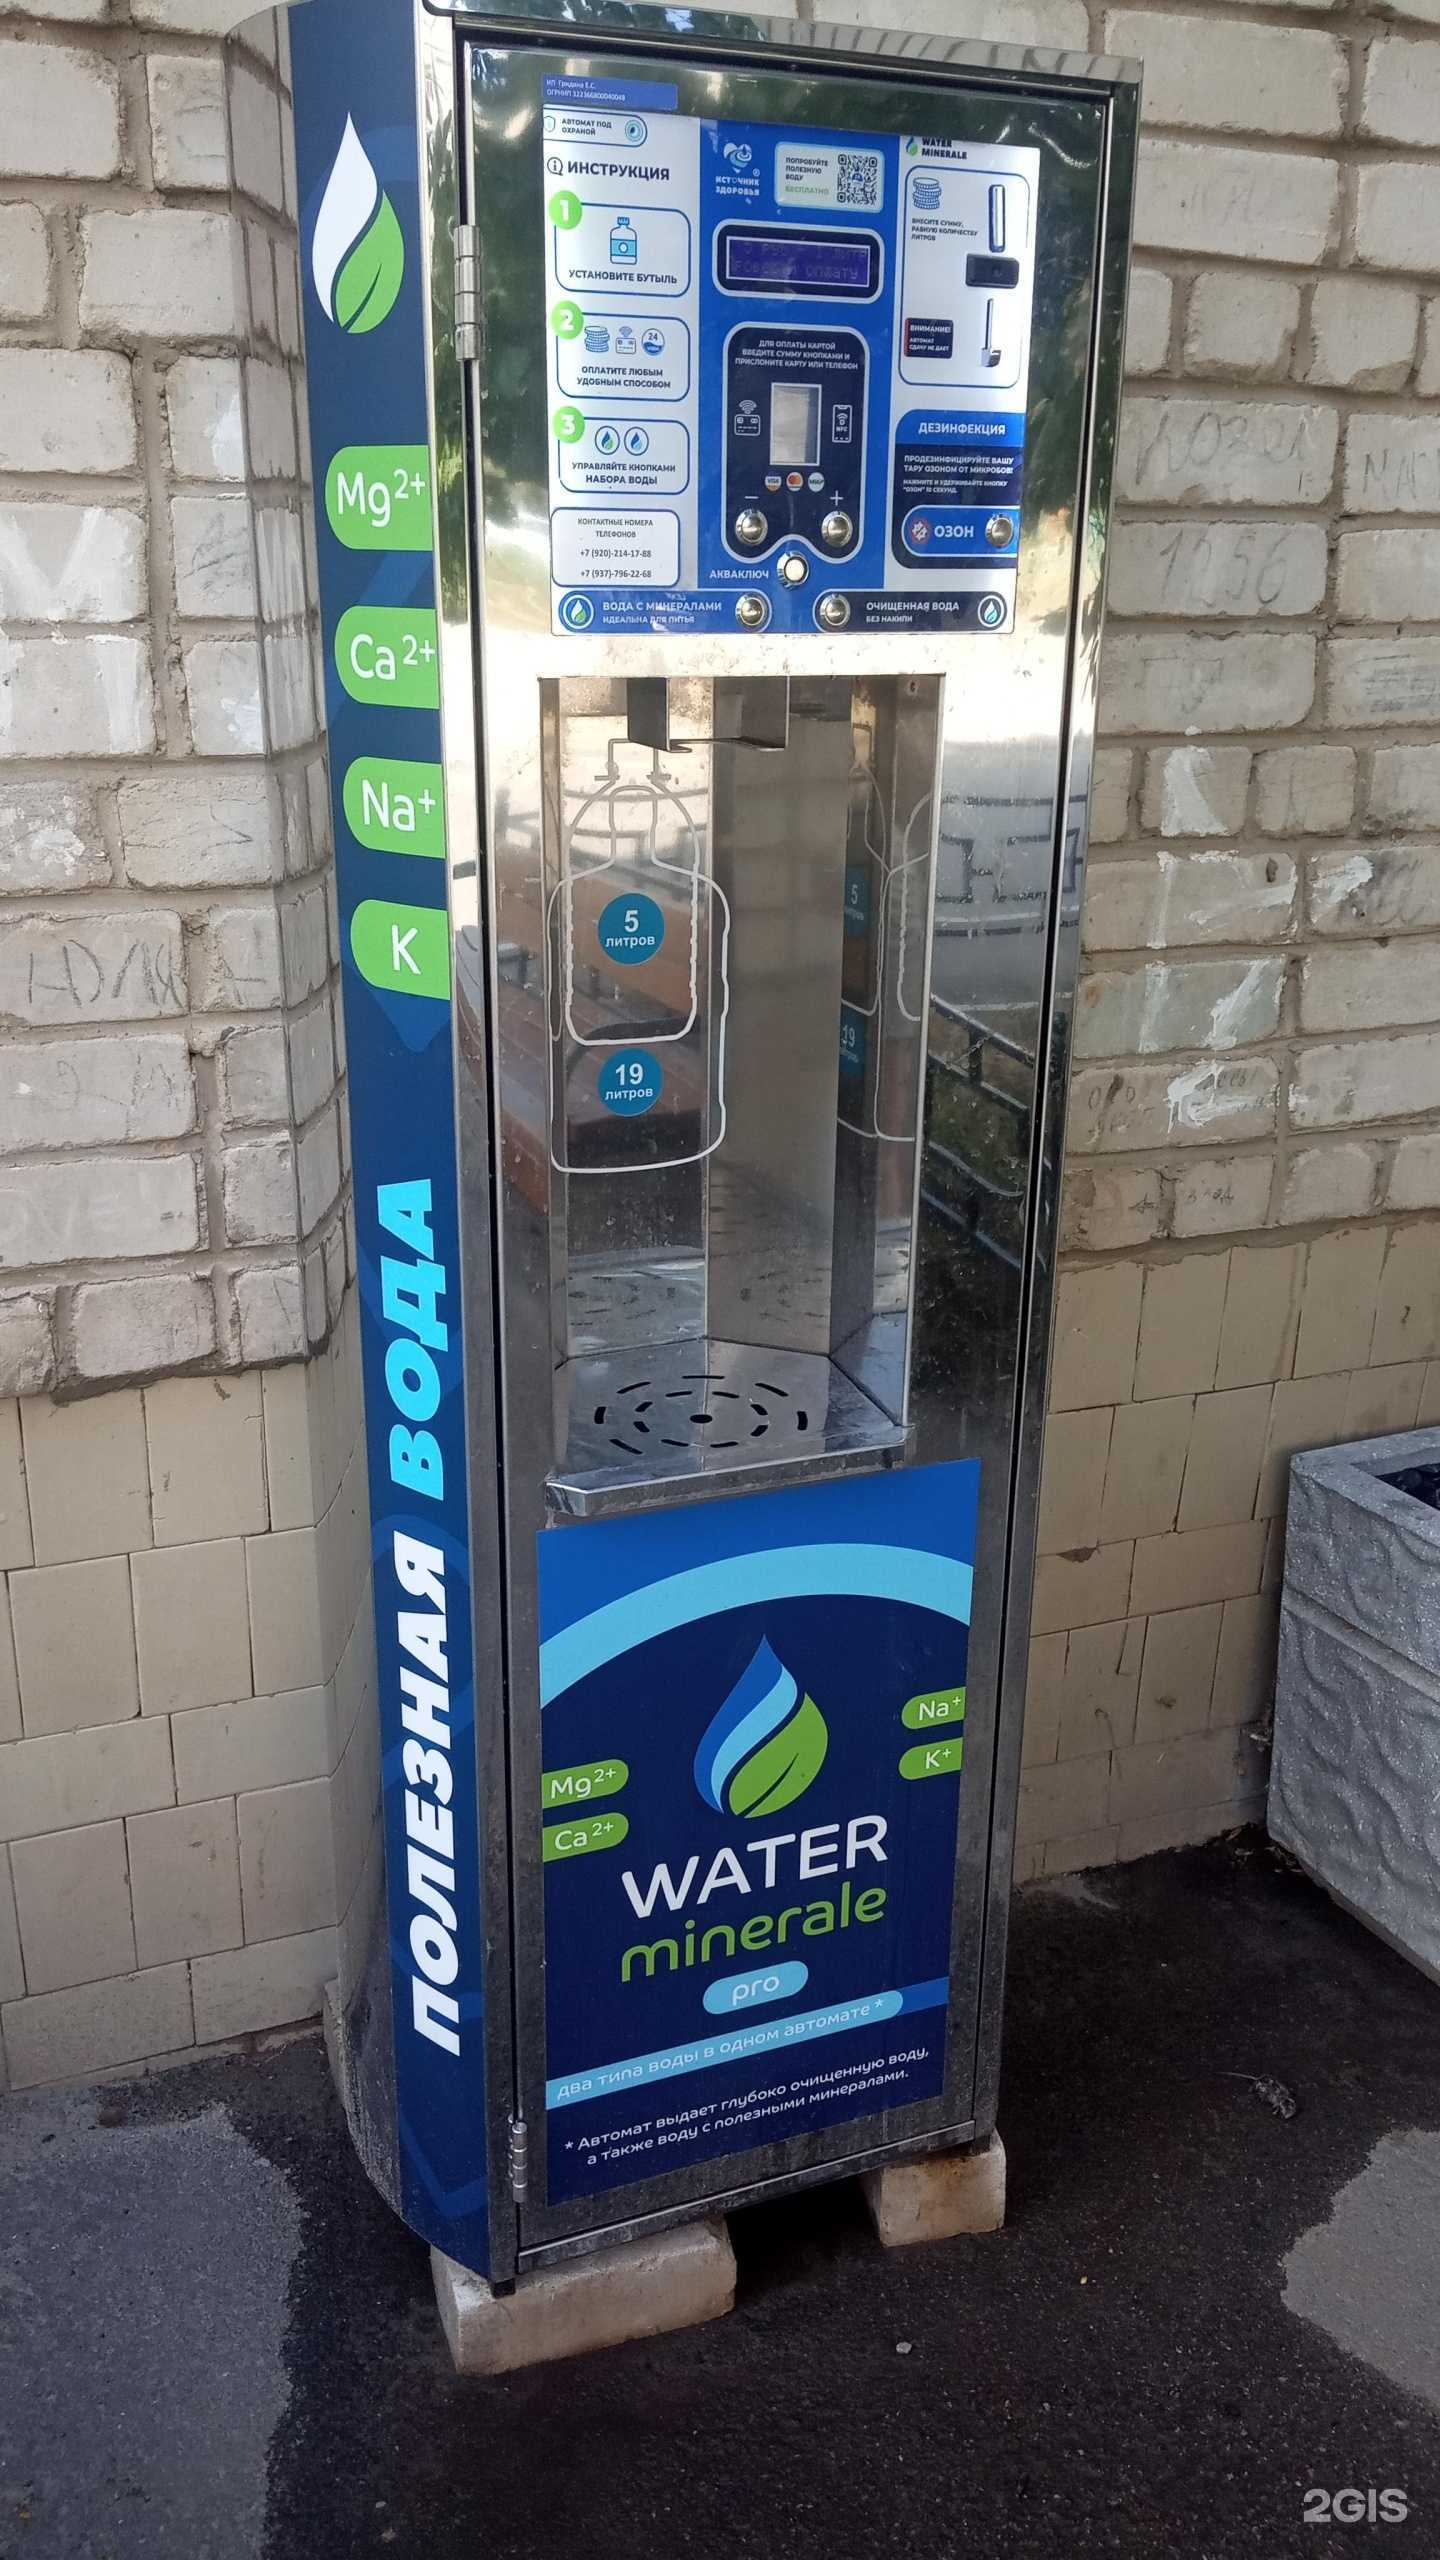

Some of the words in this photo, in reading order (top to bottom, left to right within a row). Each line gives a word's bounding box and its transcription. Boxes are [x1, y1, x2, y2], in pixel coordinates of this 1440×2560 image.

[561, 119, 595, 127] АВТОМАТ
[596, 121, 612, 129] ПОД
[561, 127, 595, 136] ОХРАНОЙ
[922, 136, 952, 148] WATER
[922, 148, 967, 160] MINERALE
[786, 156, 828, 167] ПОПРОБУЙТЕ
[568, 161, 670, 181] ИНСТРУКЦИЯ
[786, 165, 822, 175] ПОЛЕЗНУЮ
[715, 176, 760, 186] ИСТОЧНИК
[785, 174, 803, 182] ВОДУ
[716, 186, 760, 196] ЗДОРОВЬЯ
[785, 186, 829, 195] БЕСПЛАТНО
[559, 199, 569, 224] 1
[912, 218, 939, 226] ВНЕСИТЕ
[939, 228, 978, 236] КОЛИЧЕСТВУ
[569, 269, 634, 282] УСТАНОВИТЕ
[637, 273, 677, 284] БУТЫЛЬ
[559, 309, 575, 331] 2
[648, 333, 658, 341] 24
[759, 340, 774, 348] ДЛЯ
[776, 341, 806, 349] ОПЛАТЫ
[808, 341, 836, 350] КАРТОЙ
[742, 349, 774, 357] ВВЕДИТЕ
[776, 350, 802, 358] СУММУ
[803, 351, 843, 360] КНОПКАМИ
[735, 358, 783, 367] ПРИСЛОНИТЕ
[785, 360, 807, 368] КАРТУ
[808, 361, 824, 369] ИЛИ
[825, 362, 858, 370] ТЕЛЕФОН
[581, 366, 627, 376] ОПЛАТИТЕ
[628, 368, 663, 377] ЛЮБЫМ
[576, 377, 622, 387] УДОБНЫМ
[623, 379, 671, 389] СПОСОБОМ
[560, 414, 576, 436] 3
[918, 422, 1006, 436] ДЕЗИНФЕКЦИЯ
[904, 455, 991, 464] ПРОДЕЗИНФИЦИРУЙТЕ
[992, 457, 1014, 465] ВАШУ
[572, 461, 627, 472] УПРАВЛЯЙТЕ
[629, 463, 676, 473] КНОПКАМИ
[904, 465, 924, 473] ТАРУ
[925, 465, 957, 474] ОЗОНОМ
[958, 466, 968, 474] ОТ
[586, 475, 626, 484] НАБОРА
[629, 476, 658, 485] ВОДЫ
[577, 518, 623, 526] КОНТАКТНЫЕ
[624, 519, 654, 527] НОМЕРА
[595, 530, 636, 538] ТЕЛЕФОНОВ
[934, 525, 975, 538] ОЗОН
[580, 550, 590, 558] +7
[580, 570, 590, 578] +7
[709, 569, 769, 580] АКВАКЛЮЧ
[603, 602, 634, 612] ВОДА
[636, 602, 644, 611] С
[646, 601, 722, 611] МИНЕРАЛАМИ
[866, 602, 930, 612] ОЧИЩЕННАЯ
[932, 602, 960, 611] ВОДА
[603, 616, 648, 624] ИДЕАЛЬНА
[649, 616, 667, 624] ДЛЯ
[669, 615, 695, 624] ПИТЬЯ
[866, 615, 880, 623] БЕЗ
[881, 615, 913, 623] НАКИПИ
[624, 909, 640, 934] 5
[605, 933, 656, 949] литров
[391, 924, 421, 976] K
[615, 1063, 644, 1087] 19
[604, 1086, 654, 1101] литров
[377, 1178, 449, 1501] ВОДА
[393, 1530, 461, 2057] ПОЛЕЗНАЯ
[620, 1814, 889, 1920] WATER
[620, 1881, 888, 1984] minerale
[731, 1974, 780, 2006] pro
[557, 2078, 593, 2101] два
[598, 2063, 644, 2086] типа
[649, 2049, 699, 2074] воды
[703, 2044, 715, 2058] в
[719, 2027, 779, 2055] одном
[783, 2003, 871, 2036] автомате
[578, 2120, 653, 2150] Автомат
[655, 2104, 718, 2129] выдает
[721, 2084, 787, 2112] глубоко
[790, 2057, 885, 2092] очищенную
[888, 2045, 930, 2065] воду,
[586, 2154, 598, 2166] а
[600, 2137, 654, 2162] также
[657, 2124, 698, 2146] воду
[702, 2122, 712, 2133] с
[713, 2095, 806, 2131] полезными
[808, 2069, 910, 2105] минералами.
